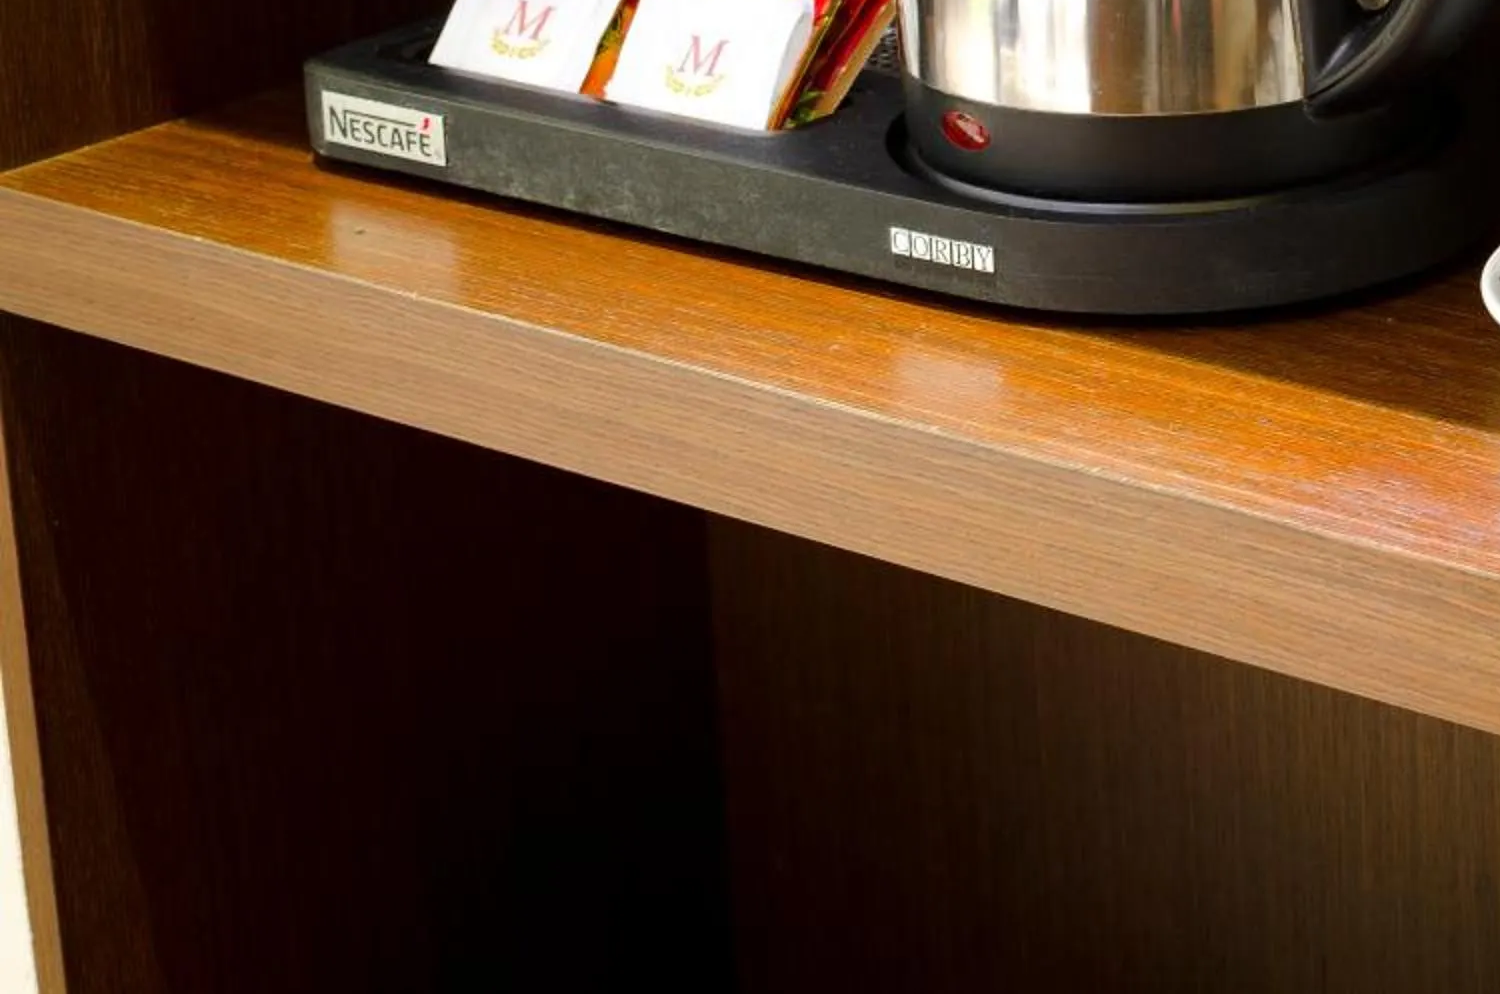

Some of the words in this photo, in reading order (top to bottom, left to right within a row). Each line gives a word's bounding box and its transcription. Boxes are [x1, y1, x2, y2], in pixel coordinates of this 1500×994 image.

[503, 0, 556, 40] M
[678, 34, 730, 77] M
[893, 229, 992, 271] CORBY
